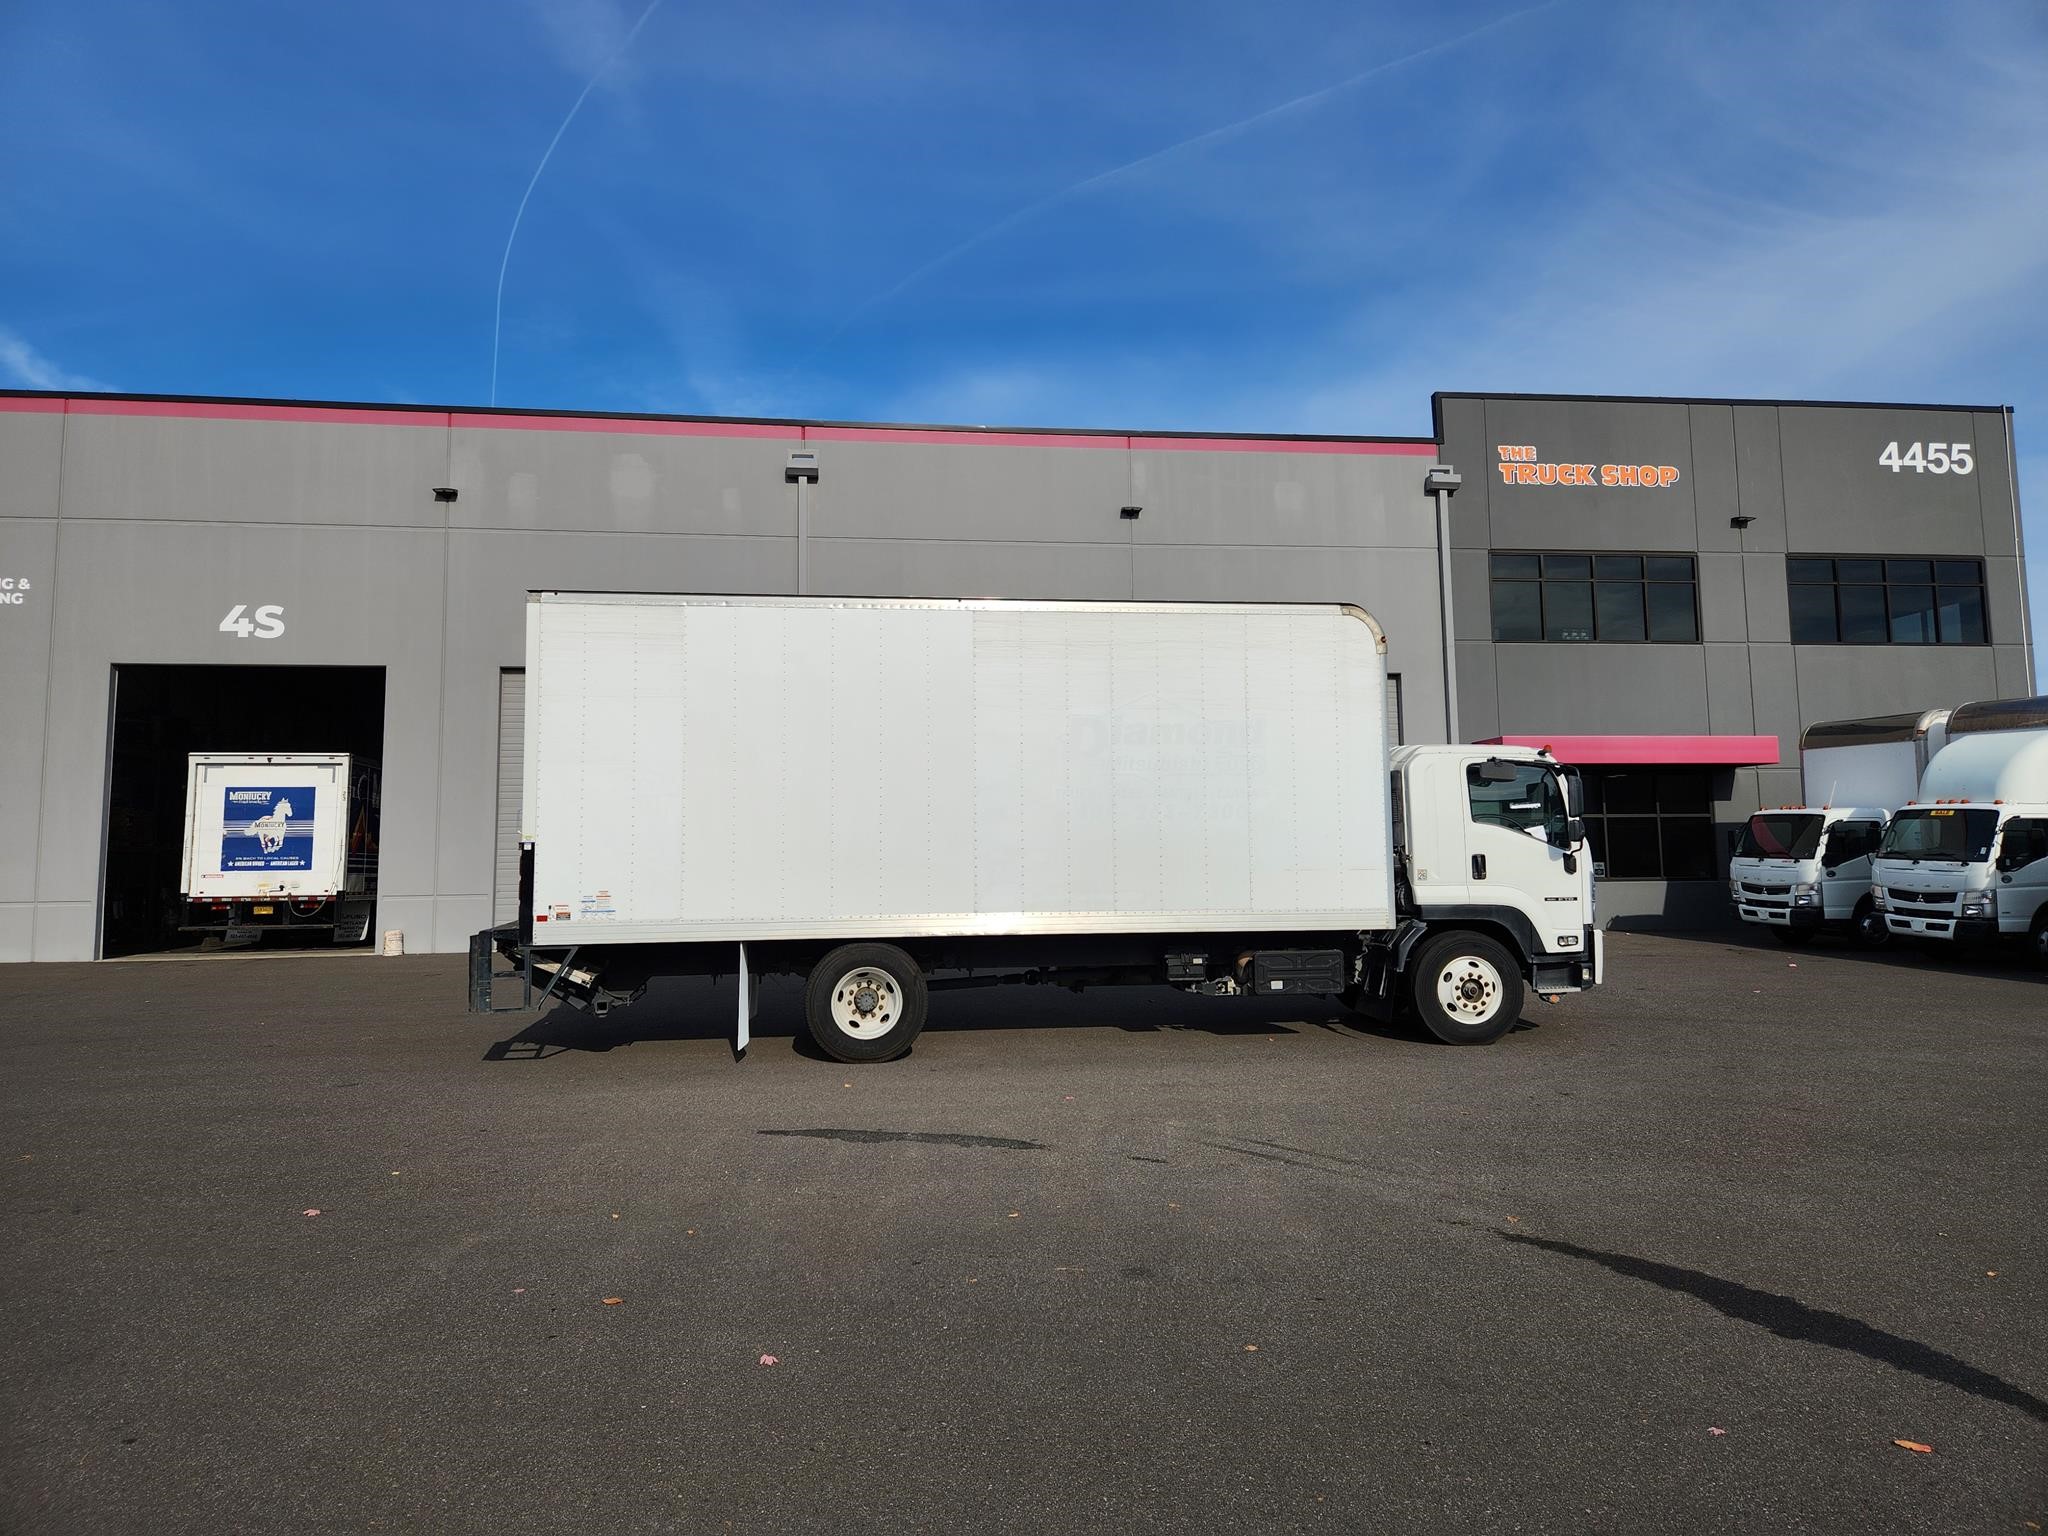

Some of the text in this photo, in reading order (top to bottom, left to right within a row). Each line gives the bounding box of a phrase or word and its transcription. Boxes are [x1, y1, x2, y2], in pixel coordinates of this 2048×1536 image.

[1498, 446, 1537, 461] THE
[1879, 441, 1974, 475] 4455
[1499, 463, 1680, 487] TRUCK SHOP
[0, 577, 31, 590] G &
[219, 604, 286, 639] 4S
